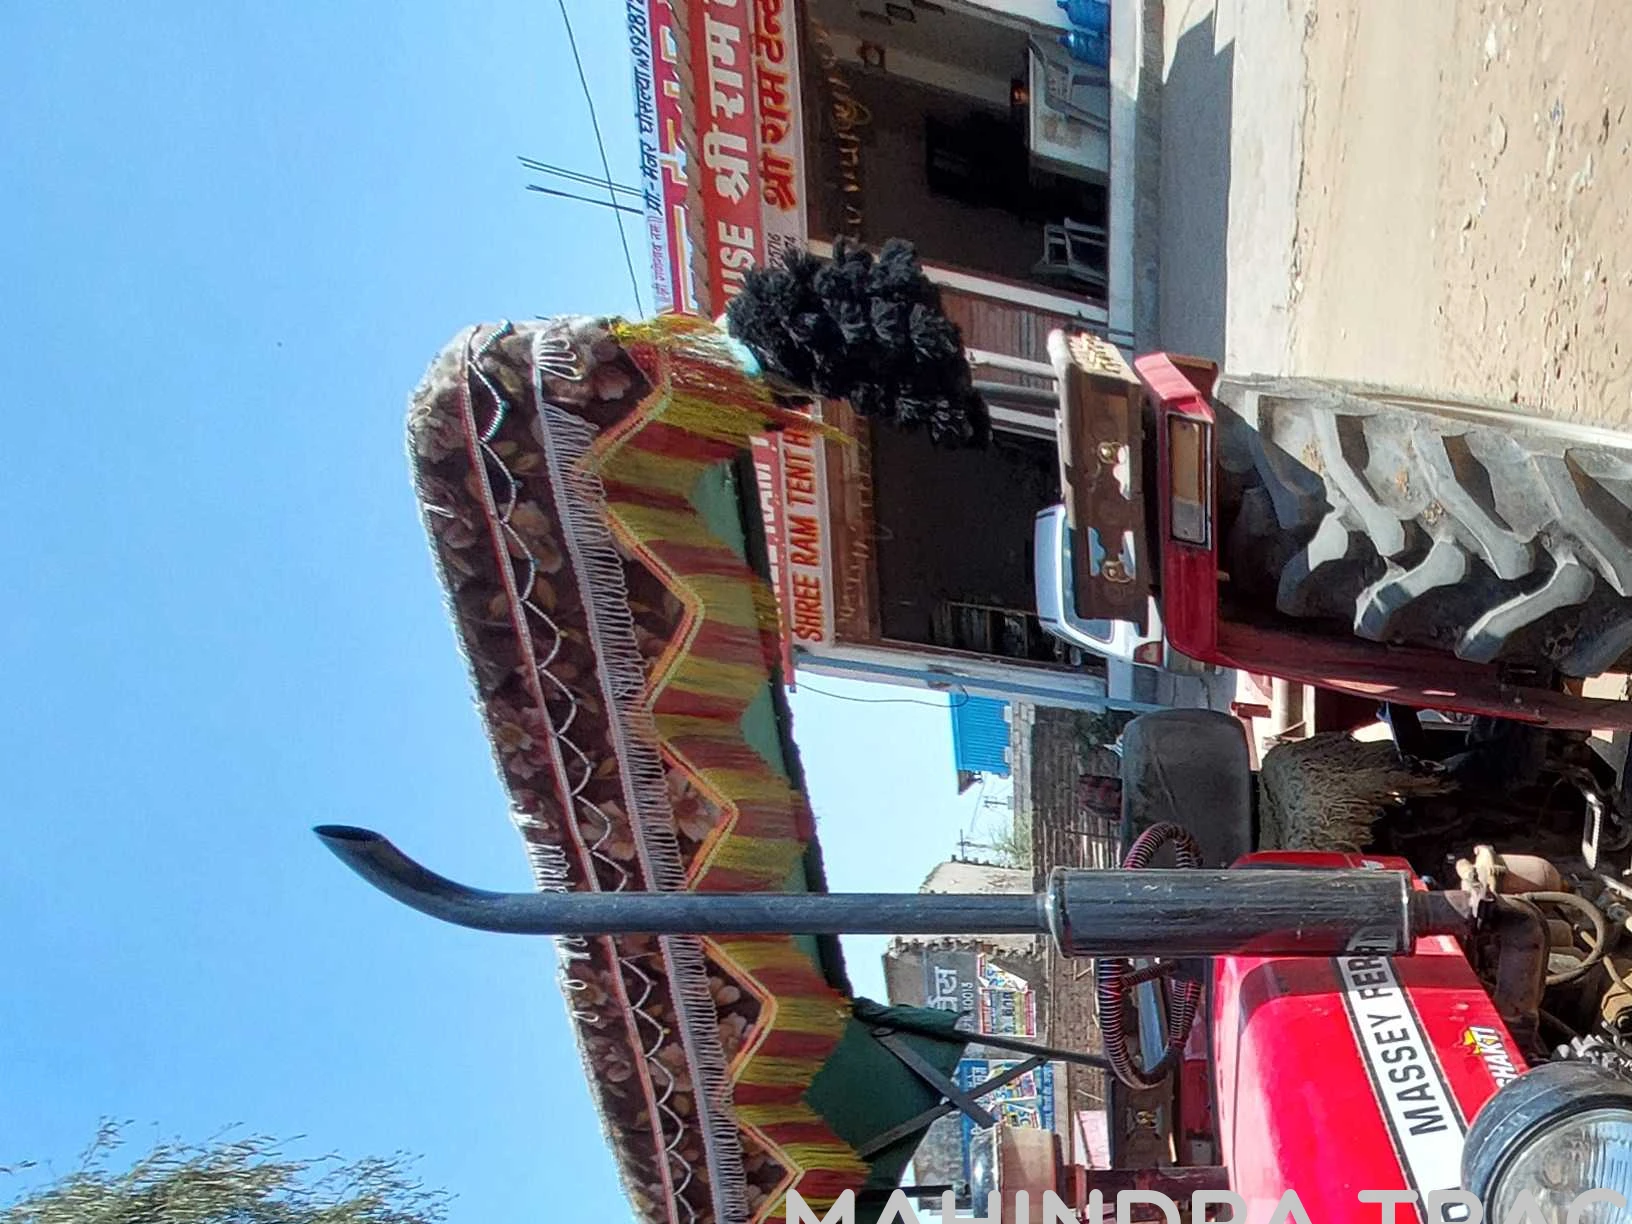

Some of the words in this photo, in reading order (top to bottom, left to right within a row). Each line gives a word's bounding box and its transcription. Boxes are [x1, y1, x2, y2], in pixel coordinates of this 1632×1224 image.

[704, 12, 746, 118] राम
[755, 63, 789, 145] राम
[702, 122, 750, 205] श्री
[756, 150, 797, 211] श्री
[718, 220, 756, 308] USE
[783, 448, 816, 507] TENT
[787, 513, 820, 567] RAM
[790, 571, 824, 642] SHREE
[1366, 1012, 1448, 1138] MASSEY
